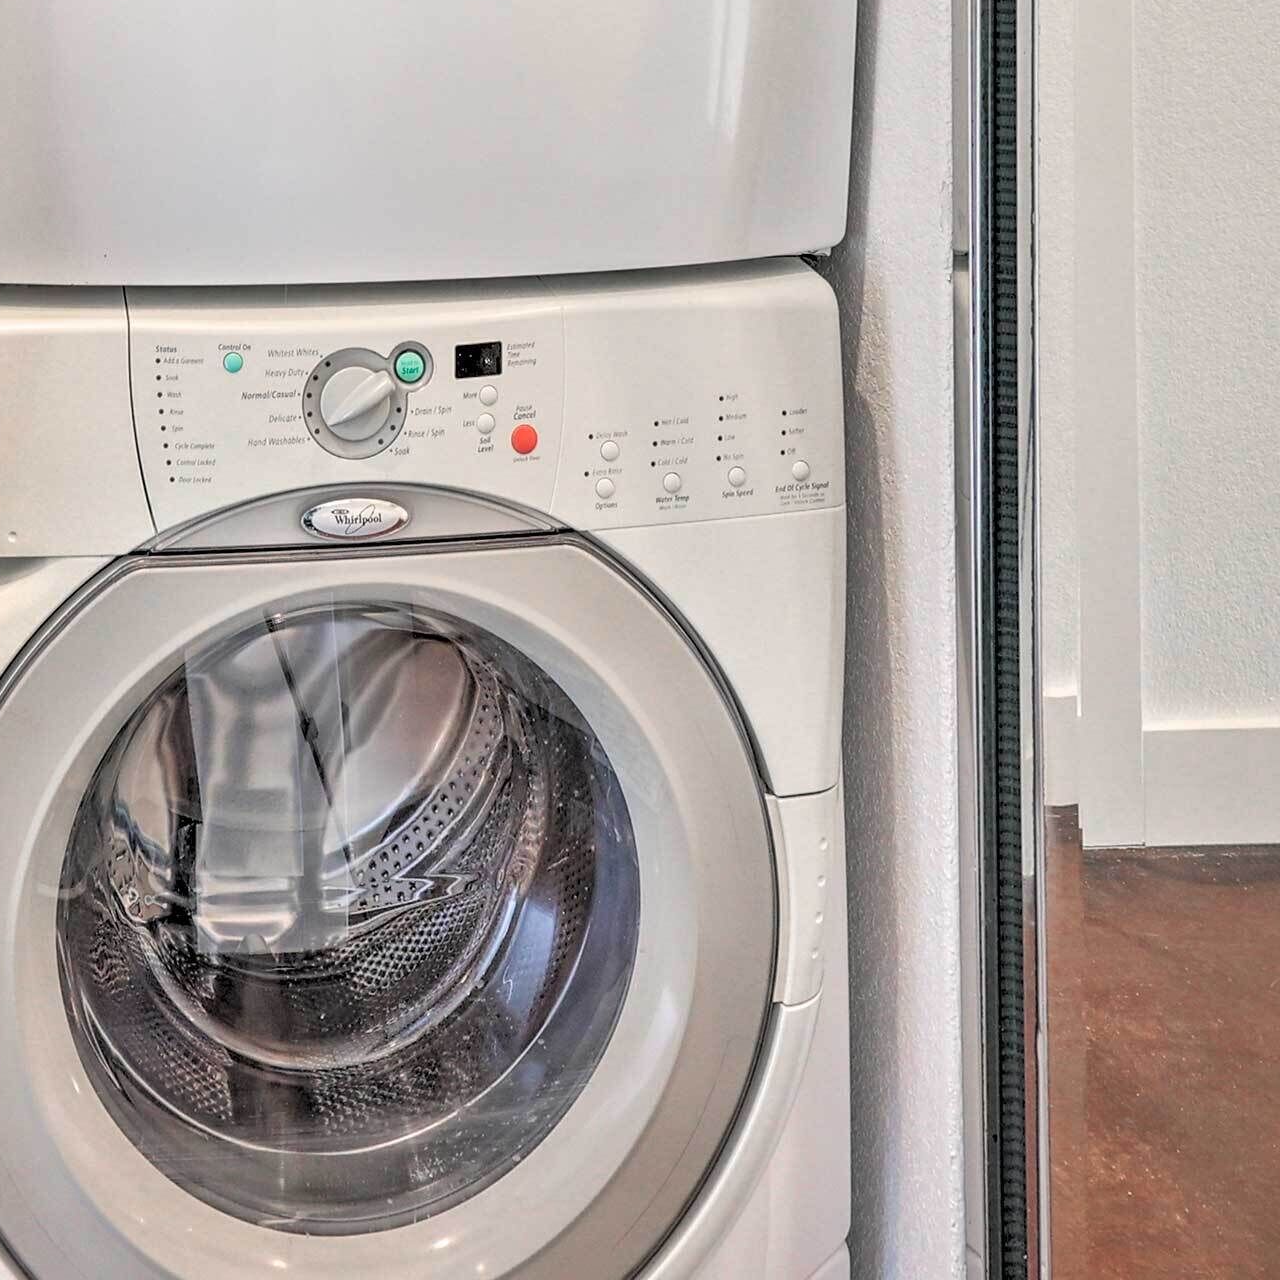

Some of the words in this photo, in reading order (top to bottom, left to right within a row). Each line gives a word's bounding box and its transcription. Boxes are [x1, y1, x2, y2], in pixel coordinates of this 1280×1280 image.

[155, 345, 177, 353] Status
[267, 348, 294, 357] Whitest
[296, 348, 319, 356] Whites
[265, 369, 286, 378] Heavy
[288, 369, 305, 377] Duty
[402, 366, 419, 375] Start
[241, 389, 297, 400] Normal/Casual
[415, 407, 432, 415] Drain
[437, 406, 452, 415] Spin
[269, 414, 297, 423] Delicate
[513, 411, 536, 420] Cancel
[408, 429, 425, 437] Rinse
[431, 429, 445, 437] Spin
[247, 439, 267, 448] Hand
[268, 437, 305, 446] Washables
[479, 436, 491, 444] Soil
[394, 447, 410, 455] Soak
[477, 444, 494, 453] Level
[775, 485, 786, 493] End
[795, 483, 810, 492] Cycle
[811, 481, 830, 490] Signal
[722, 490, 735, 498] Spin
[736, 488, 754, 497] Speed
[595, 502, 618, 510] Options
[334, 512, 382, 526] Whirlpool
